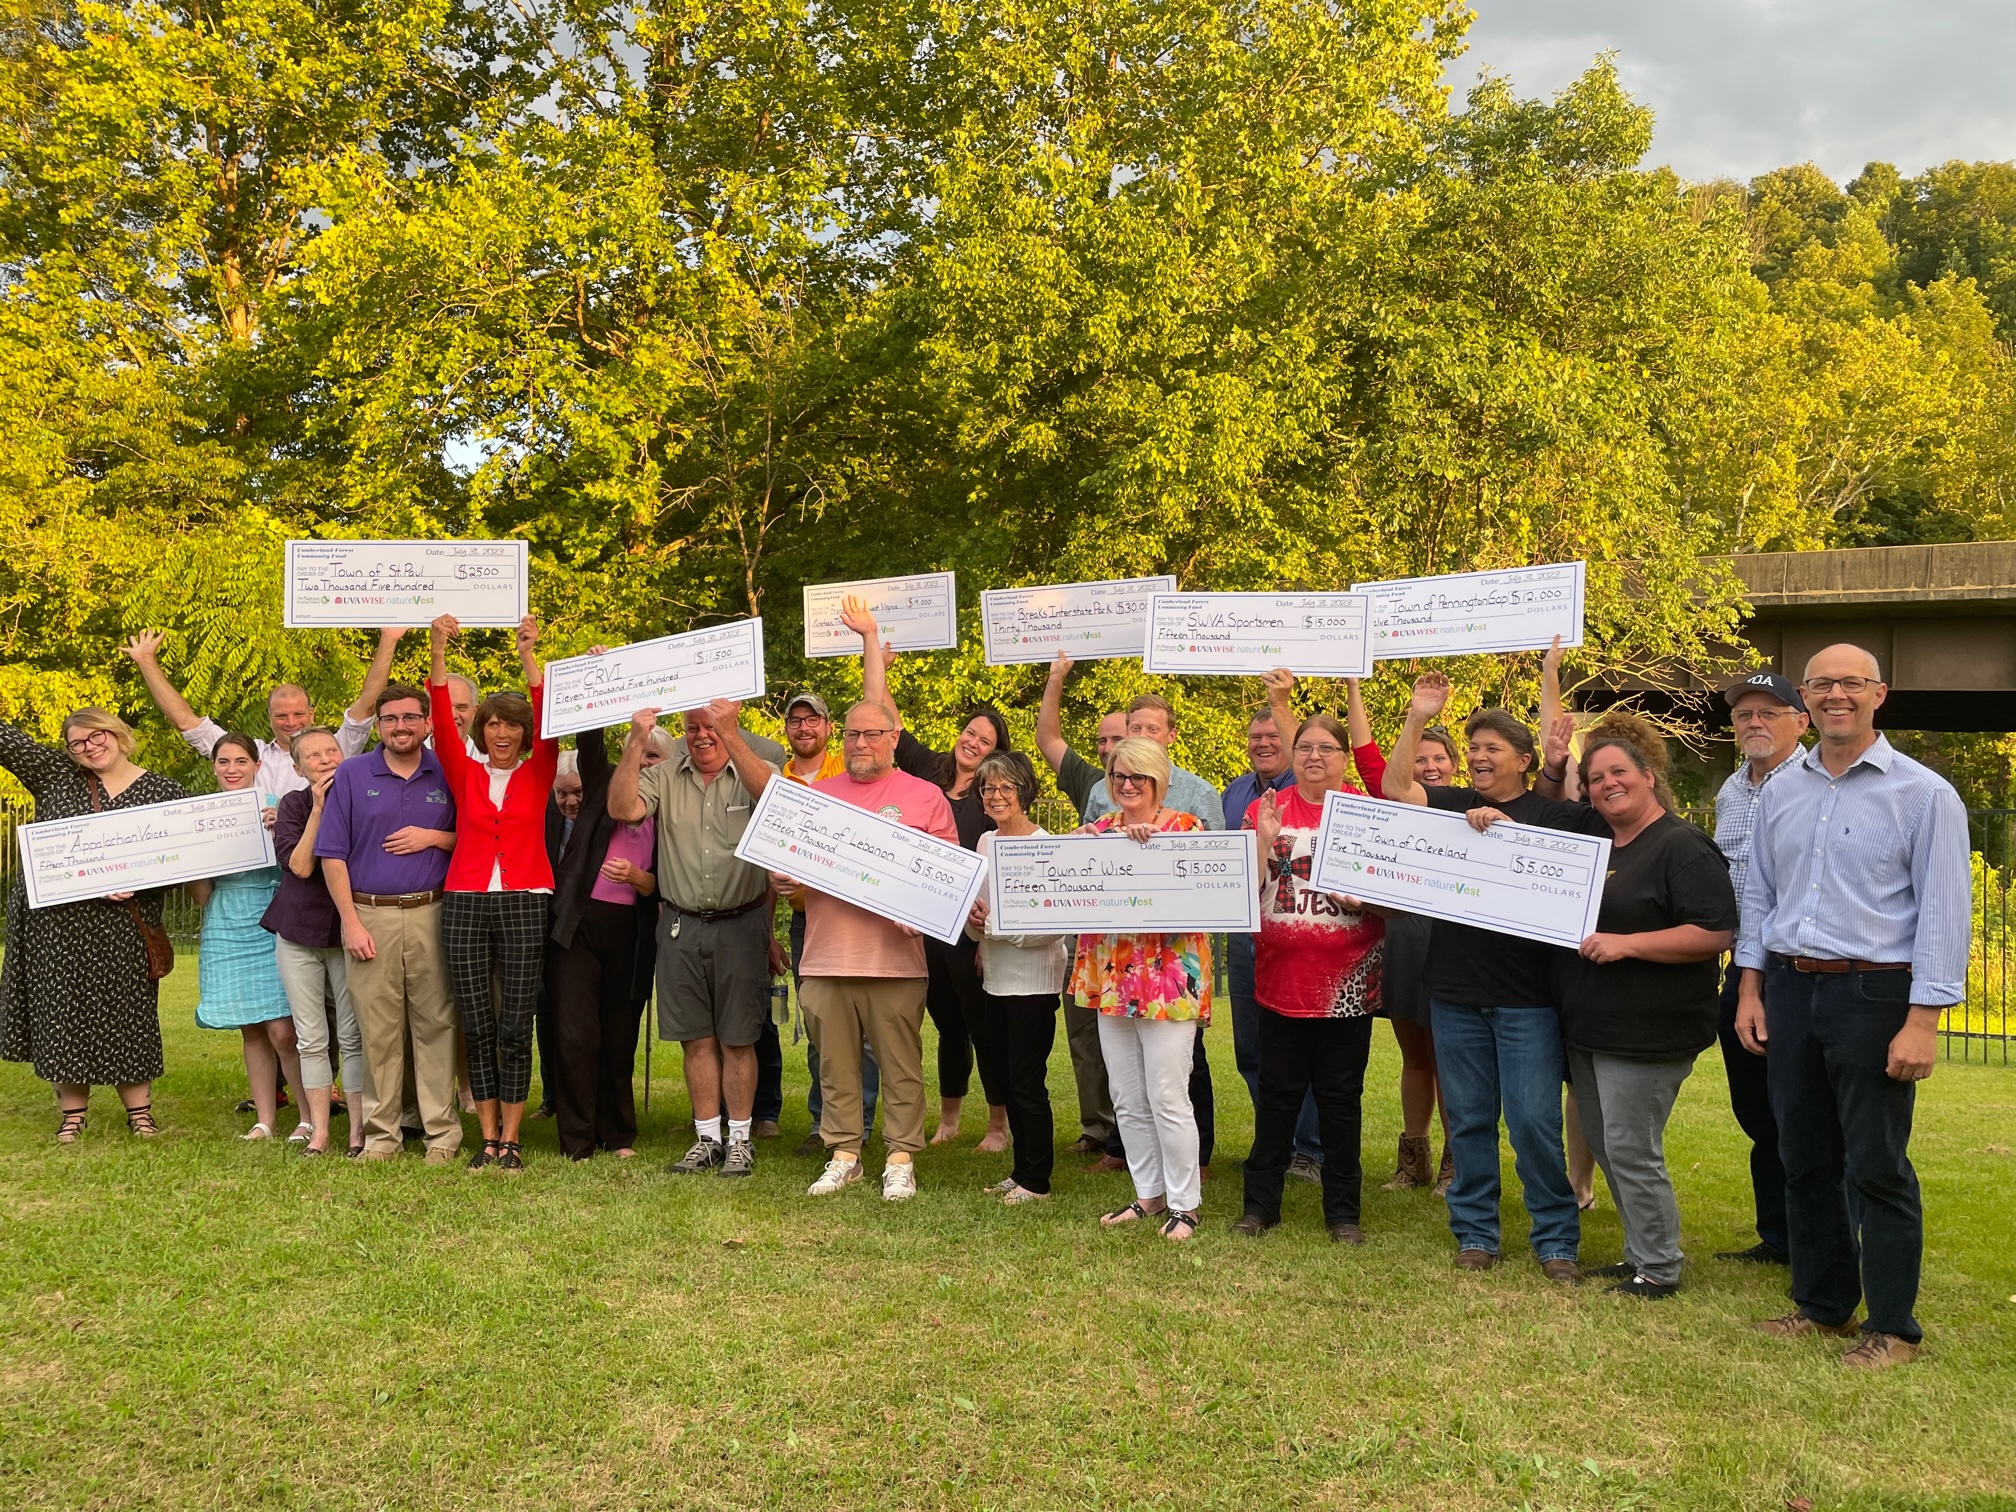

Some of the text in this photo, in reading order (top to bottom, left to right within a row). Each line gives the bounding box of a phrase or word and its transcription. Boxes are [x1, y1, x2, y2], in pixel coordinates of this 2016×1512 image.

[482, 547, 504, 555] 2023
[329, 562, 362, 577] Town
[368, 562, 383, 577] of
[454, 563, 499, 579] $2500
[1537, 570, 1560, 579] 2023
[297, 577, 434, 590] Two Thousand Five hundred
[361, 596, 384, 604] WISE
[386, 595, 434, 605] natureVest
[1388, 598, 1420, 613] Town
[1423, 594, 1436, 610] of
[918, 610, 945, 618] DOLLARS
[1048, 605, 1092, 618] Interstate
[1527, 604, 1567, 613] DOLLARS
[1186, 611, 1283, 632] SWVA Sportsmen
[1373, 612, 1432, 626] elve Thousand
[992, 619, 1062, 635] Thirty Thousand
[1157, 627, 1231, 639] Fifteen Thousand
[1416, 627, 1438, 635] WISE
[1440, 623, 1486, 633] natureVest
[1062, 631, 1101, 640] natureVest
[668, 642, 685, 650] Date
[1236, 644, 1281, 654] natureVest
[712, 659, 749, 671] DOLLARS
[583, 662, 622, 686] CRVI
[555, 671, 678, 704] Eleven Thousand Five hundred
[594, 685, 676, 708] UVA WISE natureVest
[163, 808, 182, 816] Date
[219, 797, 242, 807] 2023
[1336, 801, 1398, 816] Cumberland Forest
[1335, 807, 1389, 822] Community Fund
[216, 828, 256, 840] DOLLARS
[761, 814, 838, 853] Fifteen Thousand
[798, 809, 894, 862] Town of Lebanon
[1331, 828, 1351, 836] ORDER
[1480, 827, 1502, 839] Date
[1510, 832, 1530, 846] July
[1549, 840, 1578, 852] 2023
[70, 823, 169, 857] Appalachian Voices
[891, 830, 909, 843] Date
[943, 851, 966, 864] 2023
[1139, 842, 1160, 850] Date
[1169, 840, 1186, 851] July
[1204, 839, 1229, 848] 2023
[1367, 826, 1468, 860] Town of Cleveland
[1329, 837, 1397, 863] Five Thousand
[86, 853, 179, 875] UVA WISE natureVest
[796, 847, 880, 886] UVA WISE natureVest
[1035, 857, 1133, 877] Town of Wise
[1003, 878, 1104, 892] Fifteen Thousand
[1195, 881, 1241, 889] DOLLARS
[1376, 867, 1480, 896] UVA WISE natureVest
[921, 882, 958, 901] DOLLARS
[1531, 882, 1581, 898] DOLLARS
[1052, 896, 1152, 907] UVA WISE natureVest
[1297, 889, 1362, 917] JES
